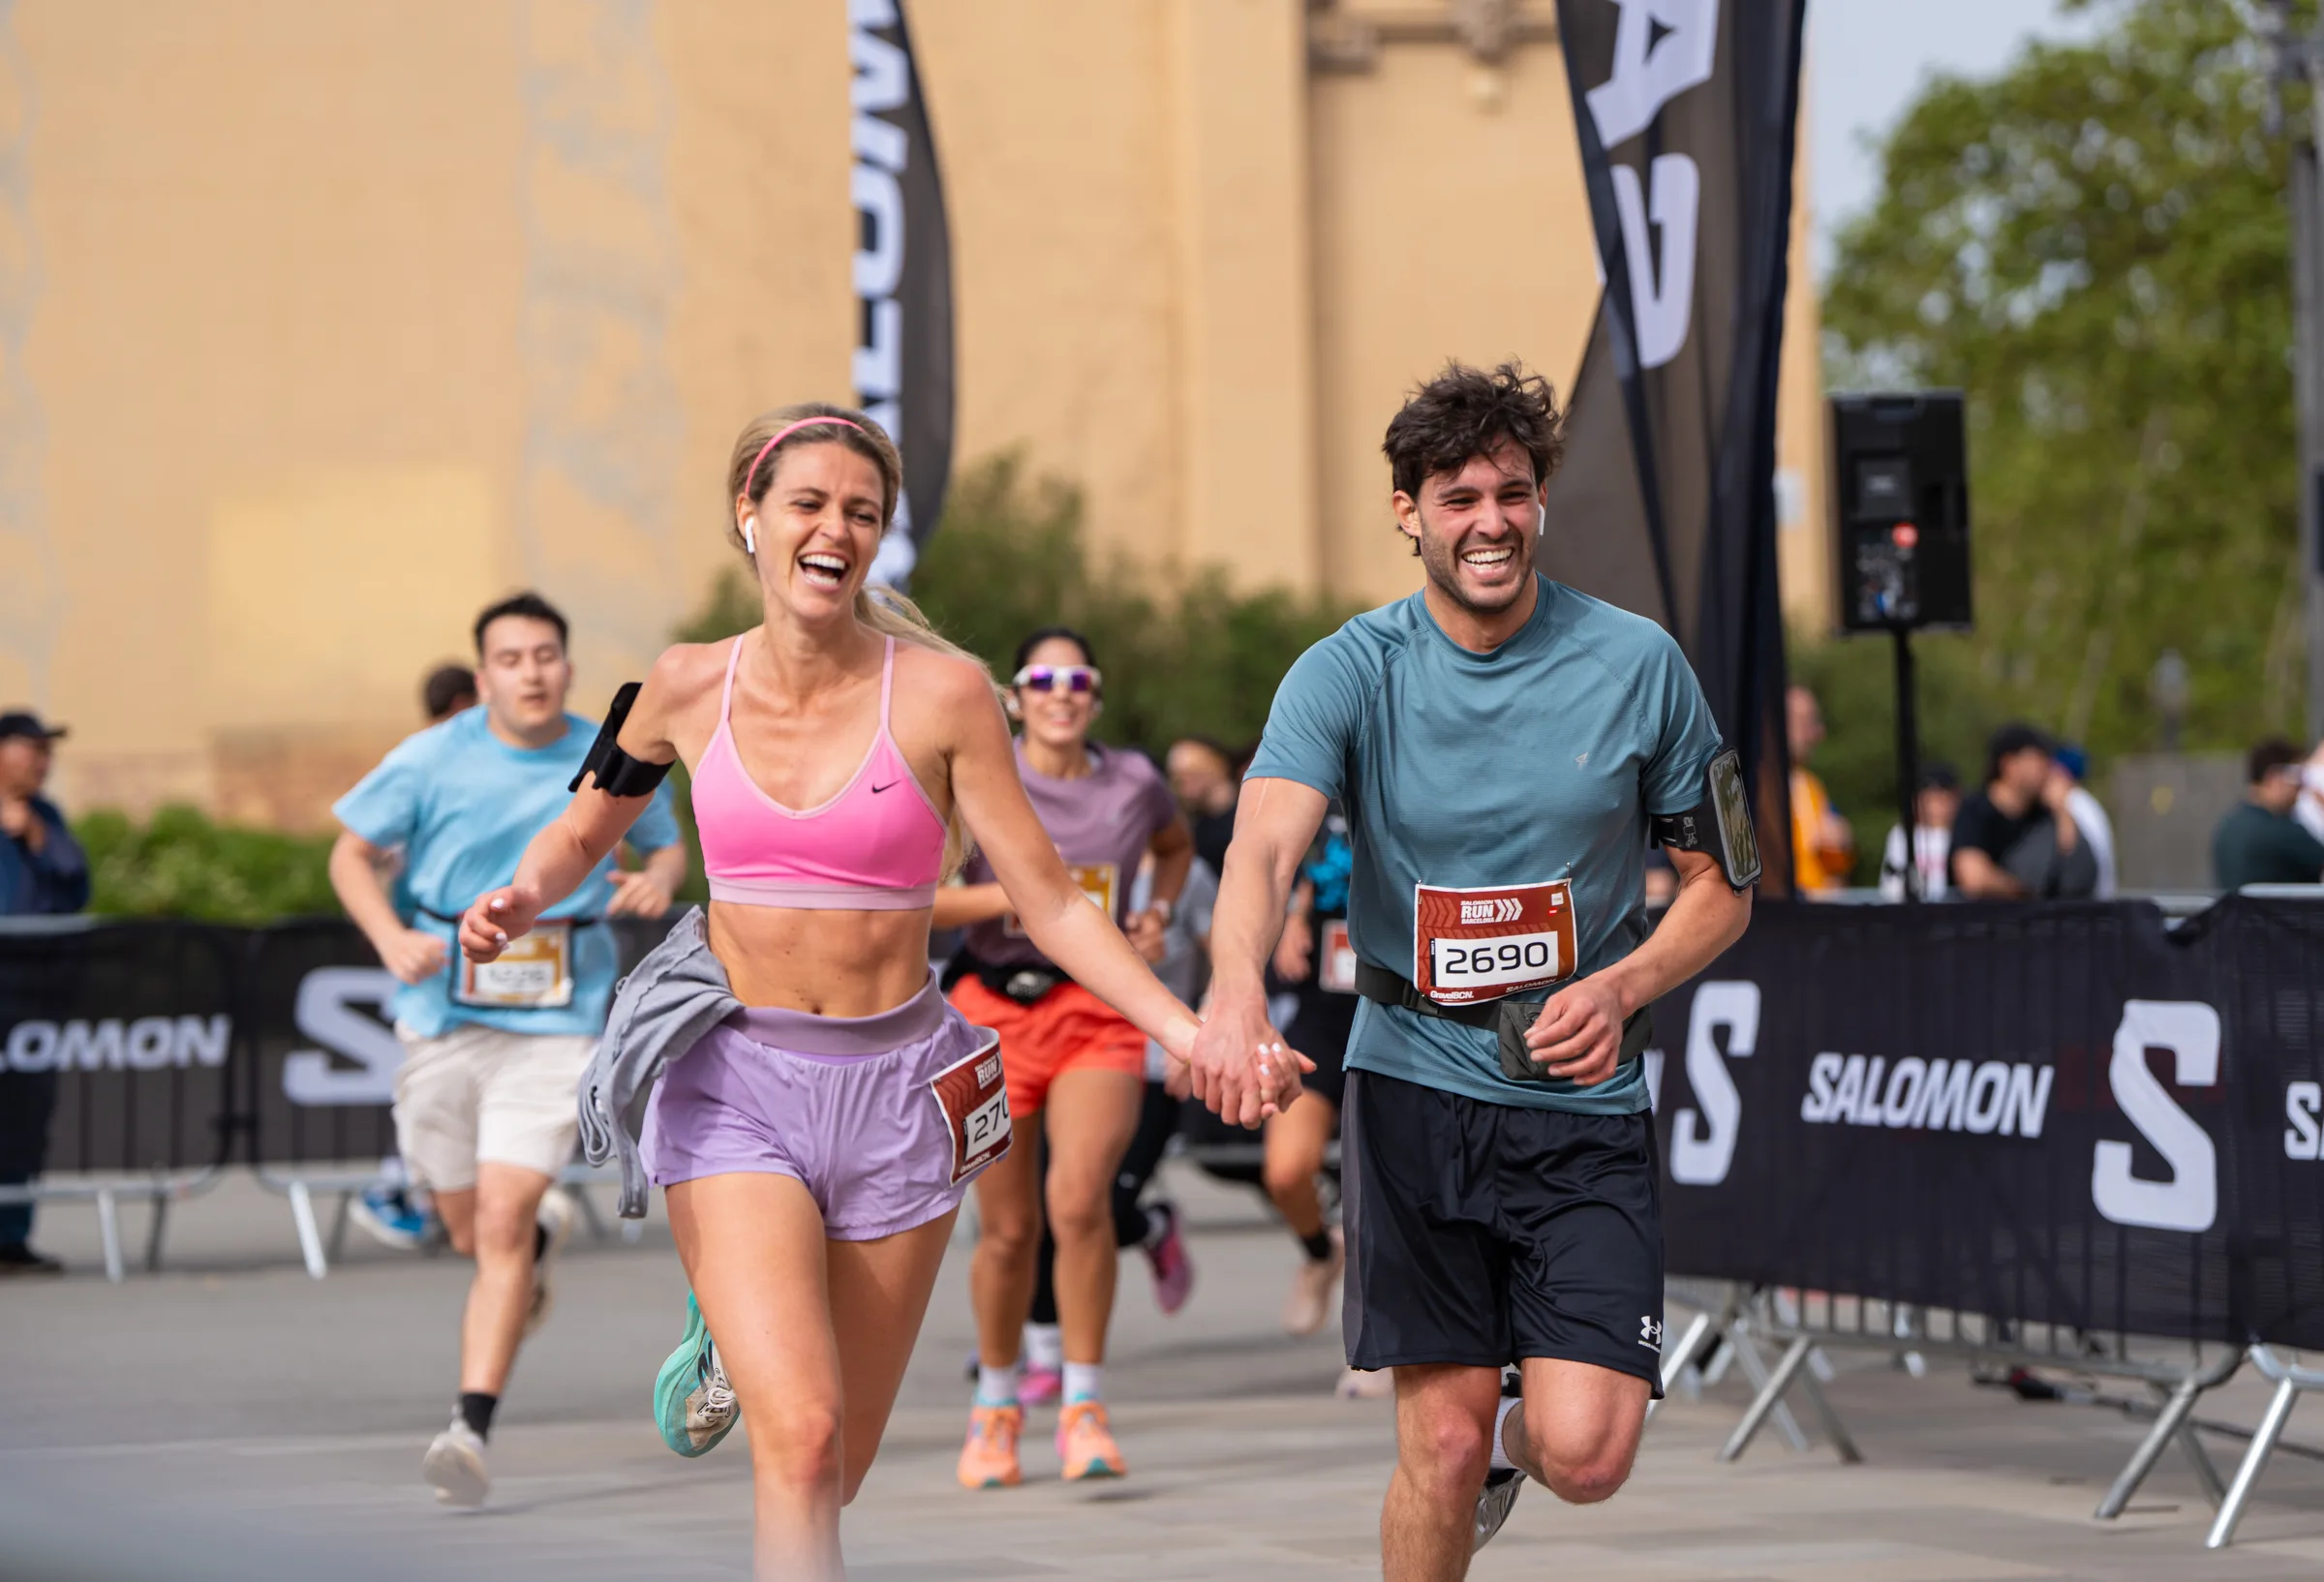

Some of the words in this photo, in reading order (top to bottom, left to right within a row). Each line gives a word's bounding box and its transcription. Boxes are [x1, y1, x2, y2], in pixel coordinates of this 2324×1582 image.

[1460, 905, 1494, 919] RUN
[1446, 941, 1548, 974] 2690
[1505, 978, 1557, 993] SALOMON
[0, 1013, 233, 1073] OMON
[976, 1059, 998, 1084] RUN
[1669, 980, 1761, 1186] S
[1800, 1051, 2055, 1140] SALOMON
[2091, 998, 2221, 1233] S
[2283, 1080, 2324, 1161] S
